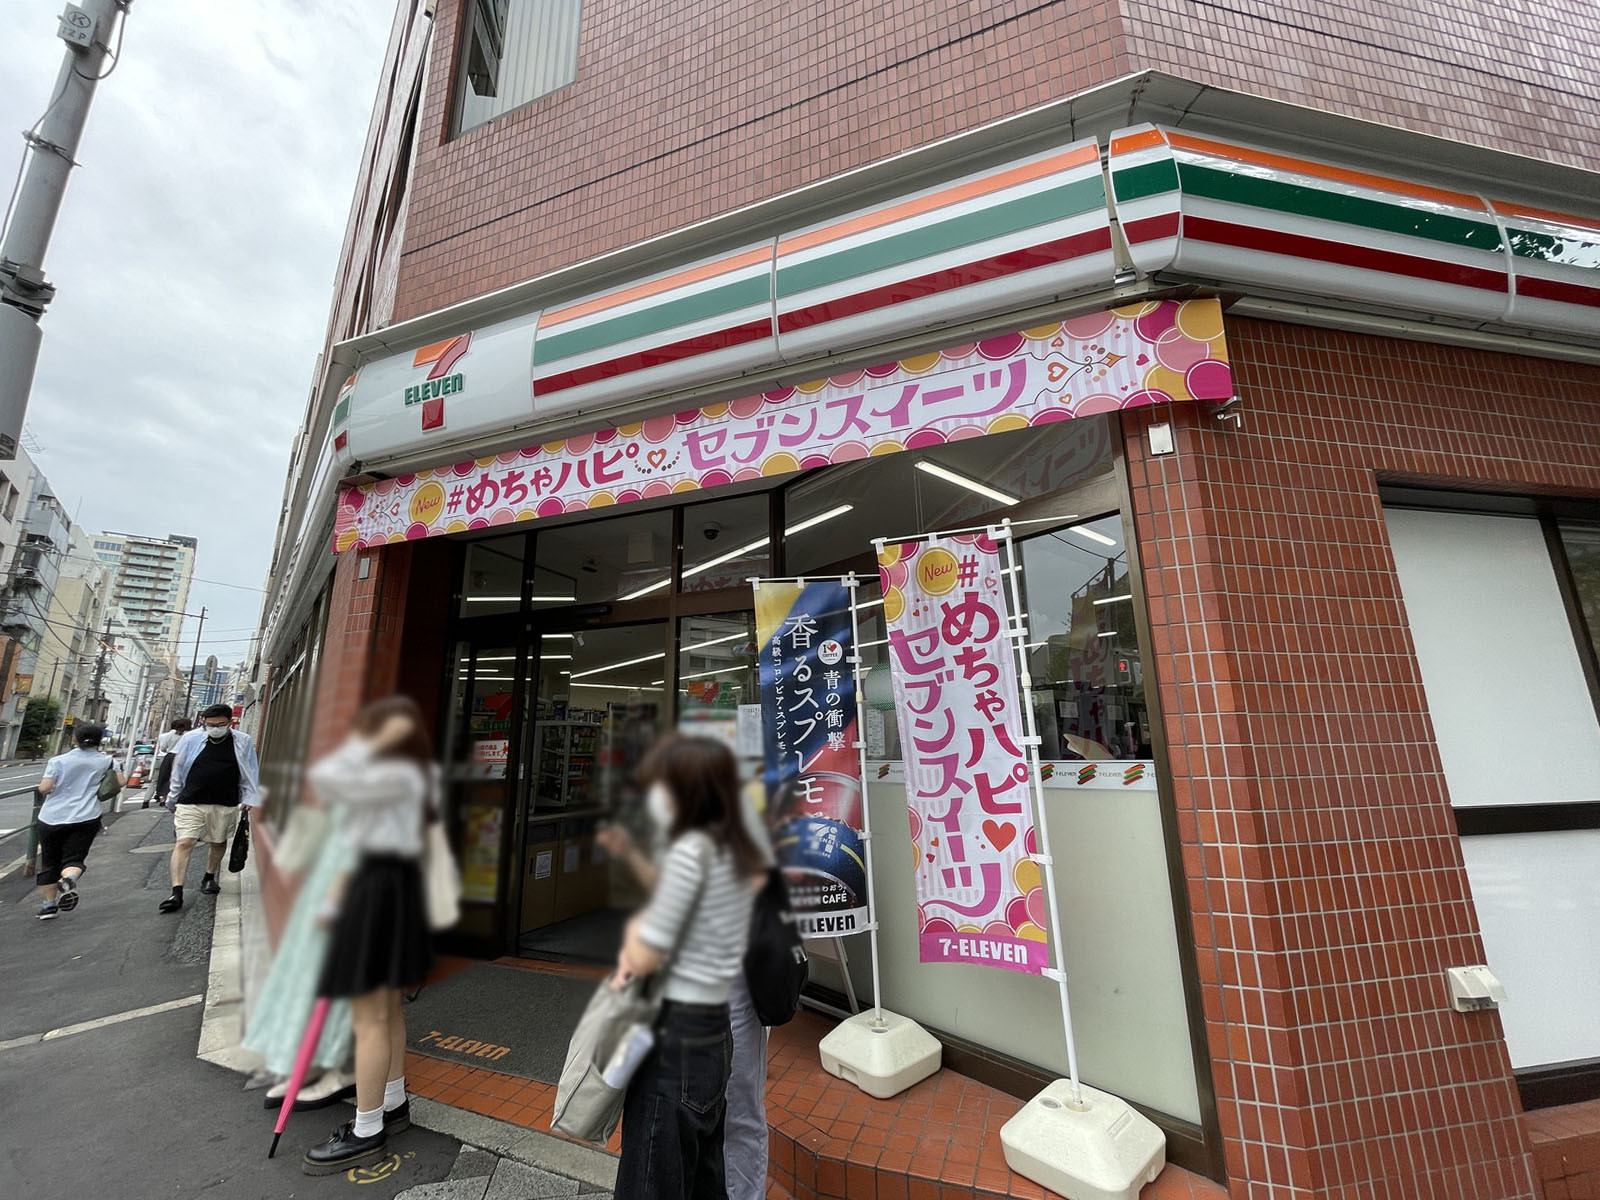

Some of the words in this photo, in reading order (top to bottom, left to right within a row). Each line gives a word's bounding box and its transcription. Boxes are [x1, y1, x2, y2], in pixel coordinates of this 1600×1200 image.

[404, 373, 464, 406] ELEVEN
[414, 495, 441, 516] New
[446, 442, 641, 516] #めちゃハピ
[681, 357, 1028, 471] セブンスイーツ
[923, 561, 954, 583] New
[783, 612, 825, 805] 香るスプレモ
[822, 669, 846, 752] 青の衝撃
[940, 553, 1029, 816] #めちゃハピ
[887, 625, 1002, 918] セブンスイーツ
[822, 890, 848, 905] CAFÉ
[938, 938, 1028, 965] 7-ELEVEN
[418, 1030, 511, 1061] 7-ELEVEN
